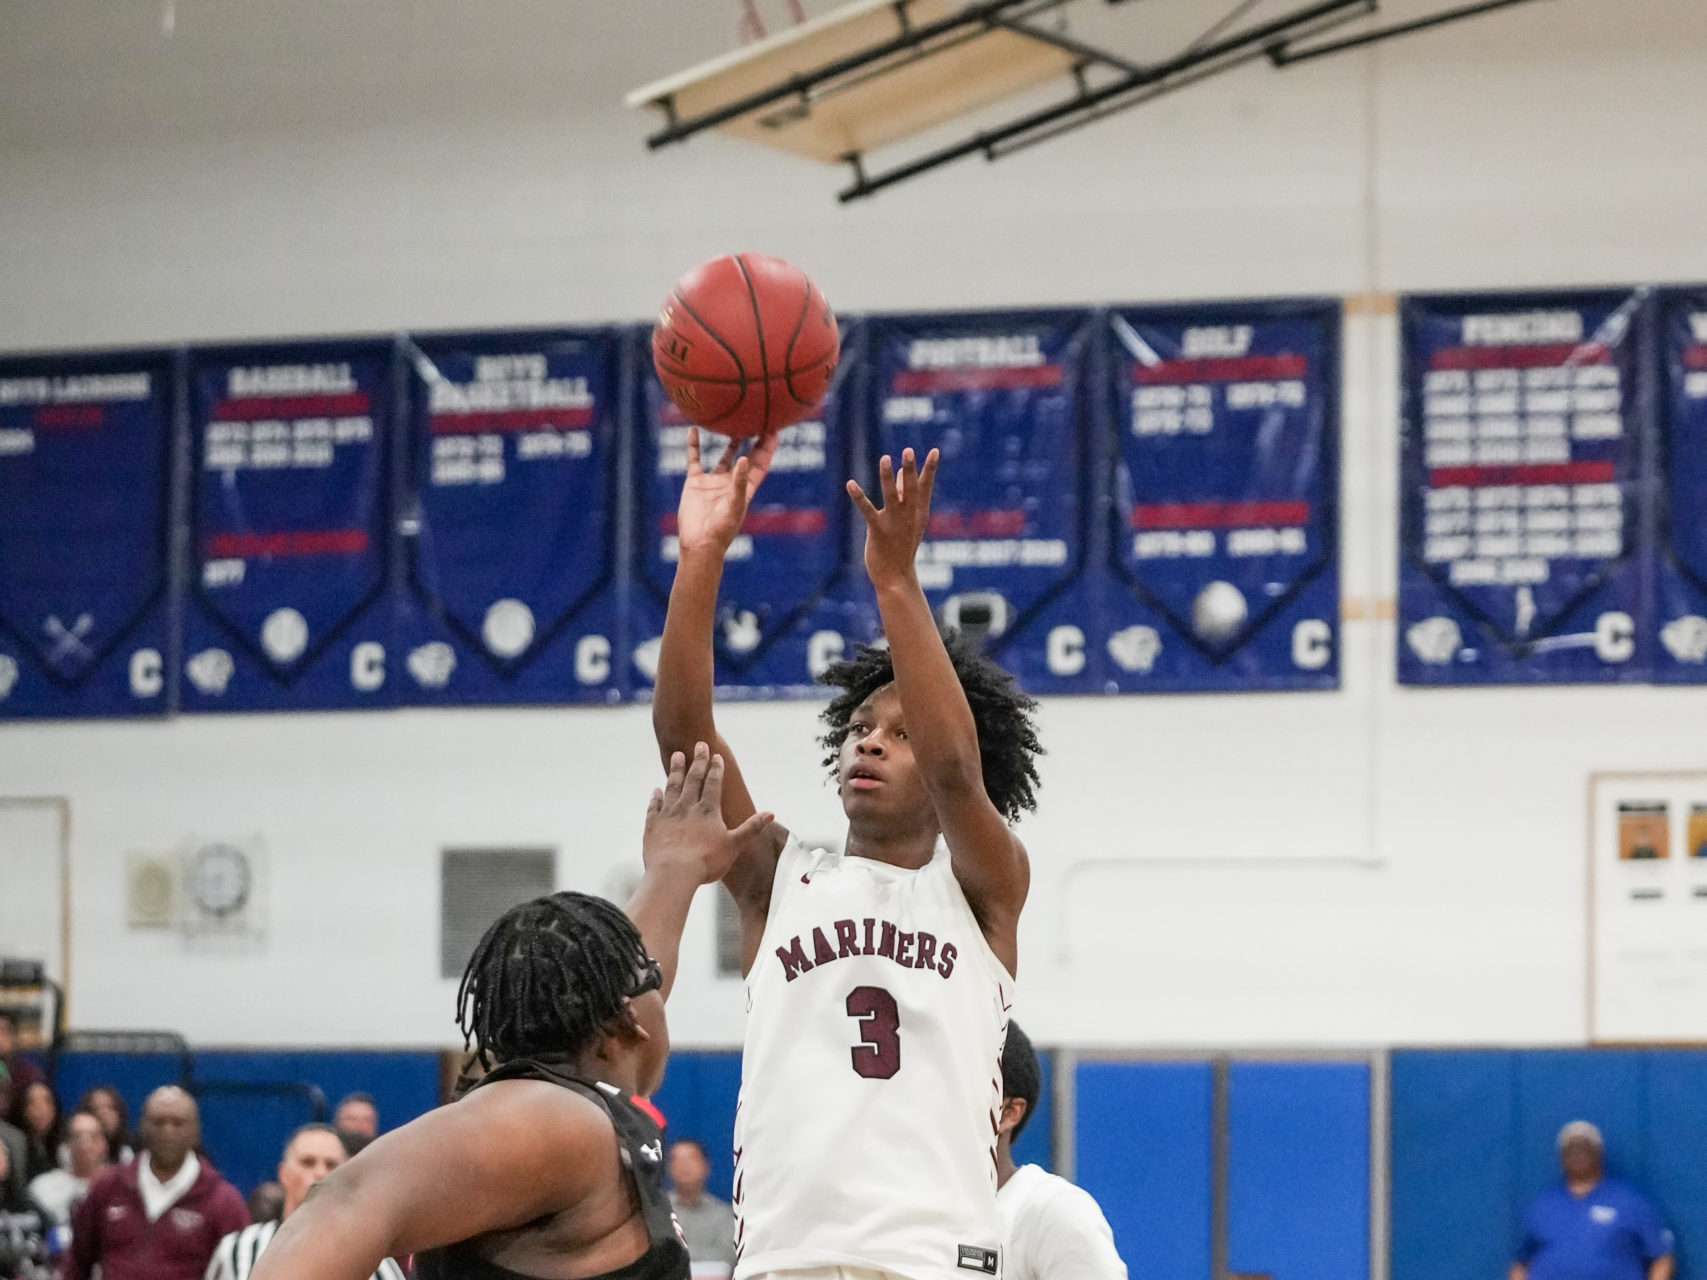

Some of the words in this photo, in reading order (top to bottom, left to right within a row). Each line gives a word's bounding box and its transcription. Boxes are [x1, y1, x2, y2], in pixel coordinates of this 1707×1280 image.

[908, 335, 1045, 369] FOOTBALL
[1181, 325, 1253, 358] GOLF
[229, 363, 358, 397] BASEBALL
[429, 377, 594, 414] BASKETBALL
[575, 635, 611, 684] C
[1046, 625, 1085, 675] C
[1292, 619, 1331, 670] C
[1596, 611, 1635, 662] C
[129, 648, 163, 697] C
[351, 641, 386, 691] C
[775, 917, 958, 983] MARINERS
[845, 985, 901, 1080] 3
